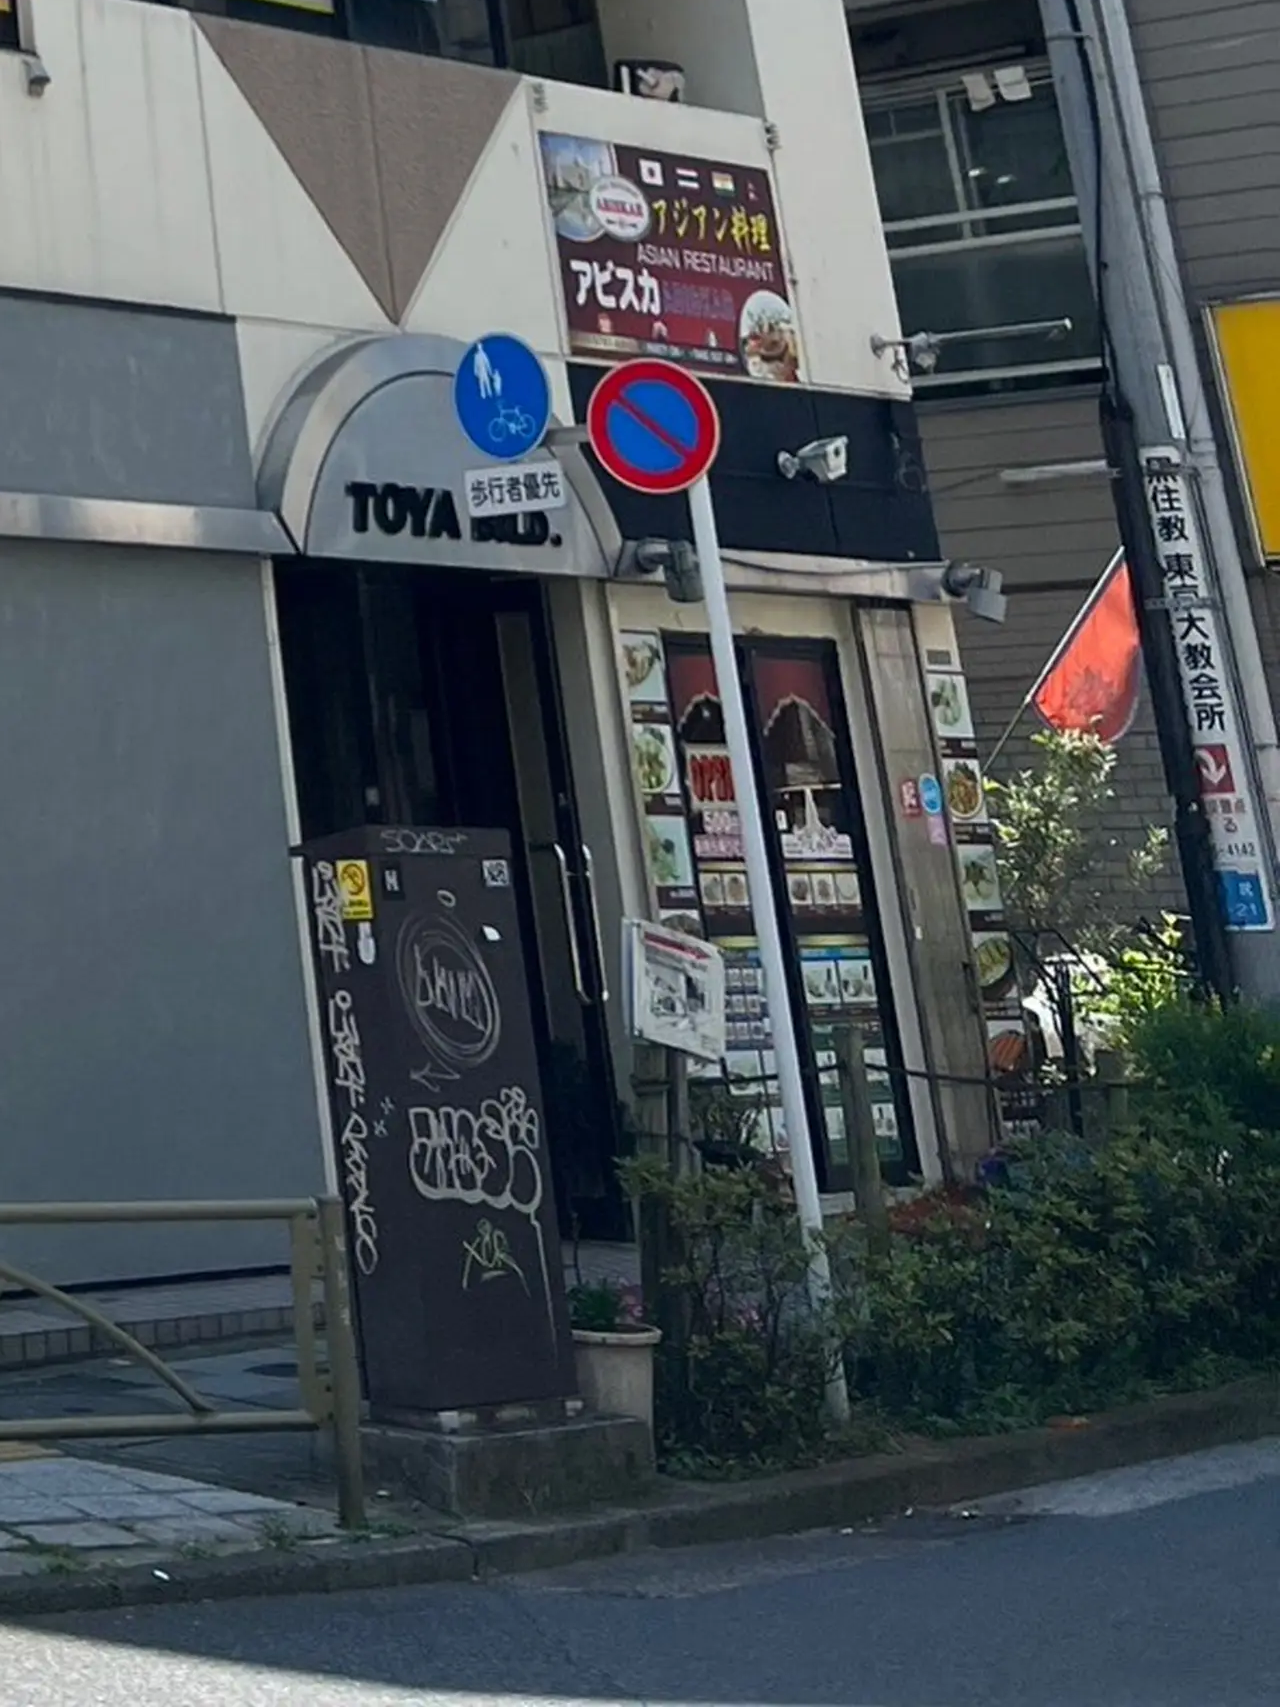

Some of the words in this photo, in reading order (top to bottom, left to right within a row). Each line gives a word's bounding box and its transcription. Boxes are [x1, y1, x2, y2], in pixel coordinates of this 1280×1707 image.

[651, 197, 772, 254] アジアン料理
[569, 259, 662, 316] アビスカ
[636, 242, 683, 271] ASIAN
[682, 250, 775, 283] RESTAURANT
[344, 480, 462, 541] TOYA
[470, 471, 561, 508] 歩行者優先
